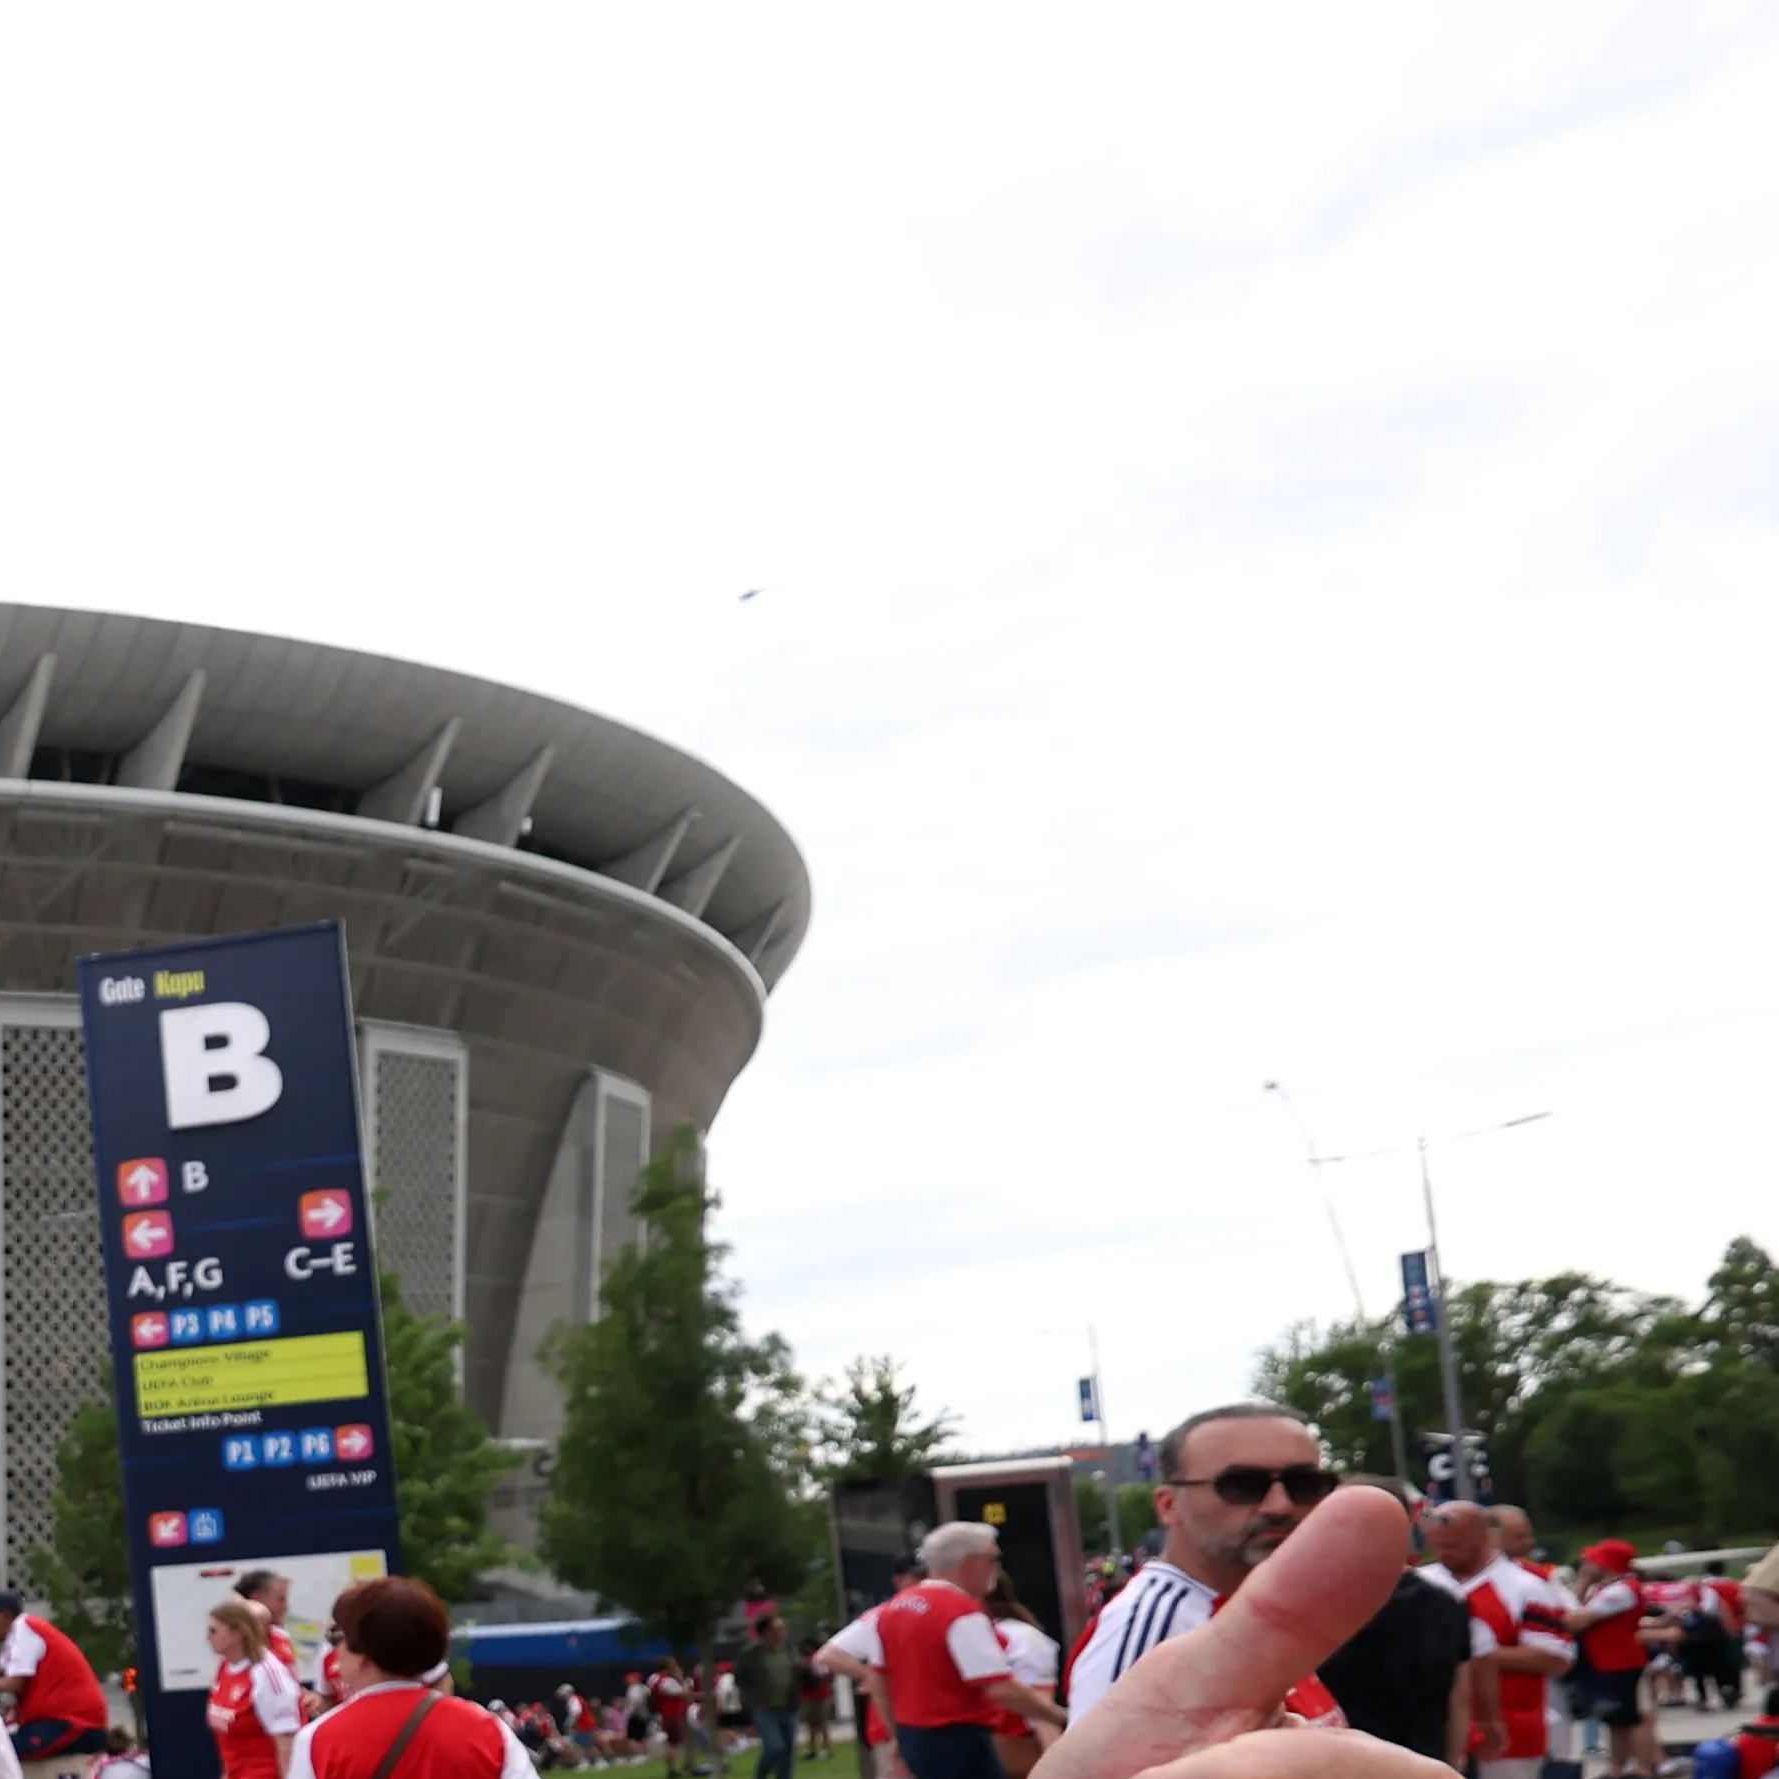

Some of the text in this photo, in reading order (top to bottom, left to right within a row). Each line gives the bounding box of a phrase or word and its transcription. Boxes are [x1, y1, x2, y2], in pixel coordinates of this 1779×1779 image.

[99, 970, 205, 1006] Gate Kapu
[159, 1001, 284, 1129] B
[181, 1160, 209, 1194] B
[127, 1257, 223, 1301] A,F,G
[172, 1304, 274, 1336] P3 P4 P5
[226, 1433, 330, 1463] P1 P2 P6
